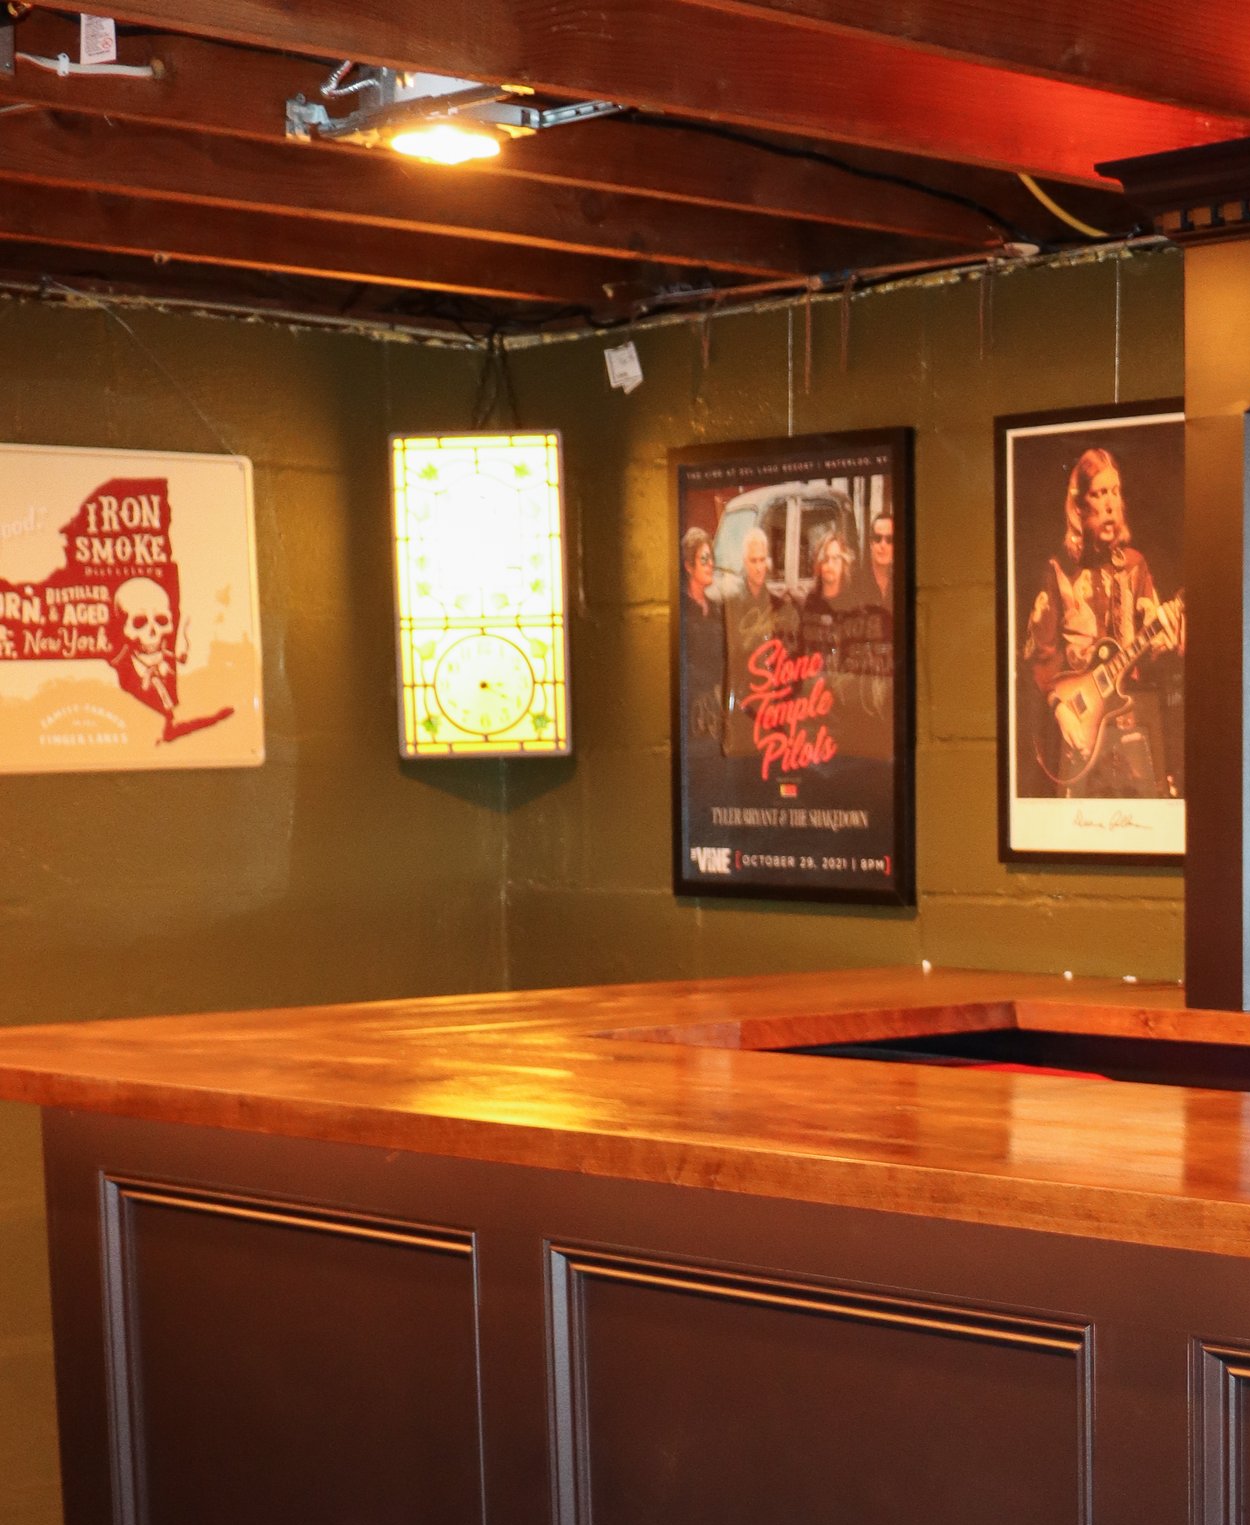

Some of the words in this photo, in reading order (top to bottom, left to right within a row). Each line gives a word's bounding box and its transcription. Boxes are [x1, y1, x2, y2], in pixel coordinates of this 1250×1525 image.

[86, 494, 161, 534] IRON
[75, 534, 167, 567] SMOKE
[62, 603, 110, 626] AGED
[23, 628, 61, 655] New
[747, 639, 824, 692] Stone
[740, 678, 832, 746] Temple
[757, 725, 837, 781] Pilots
